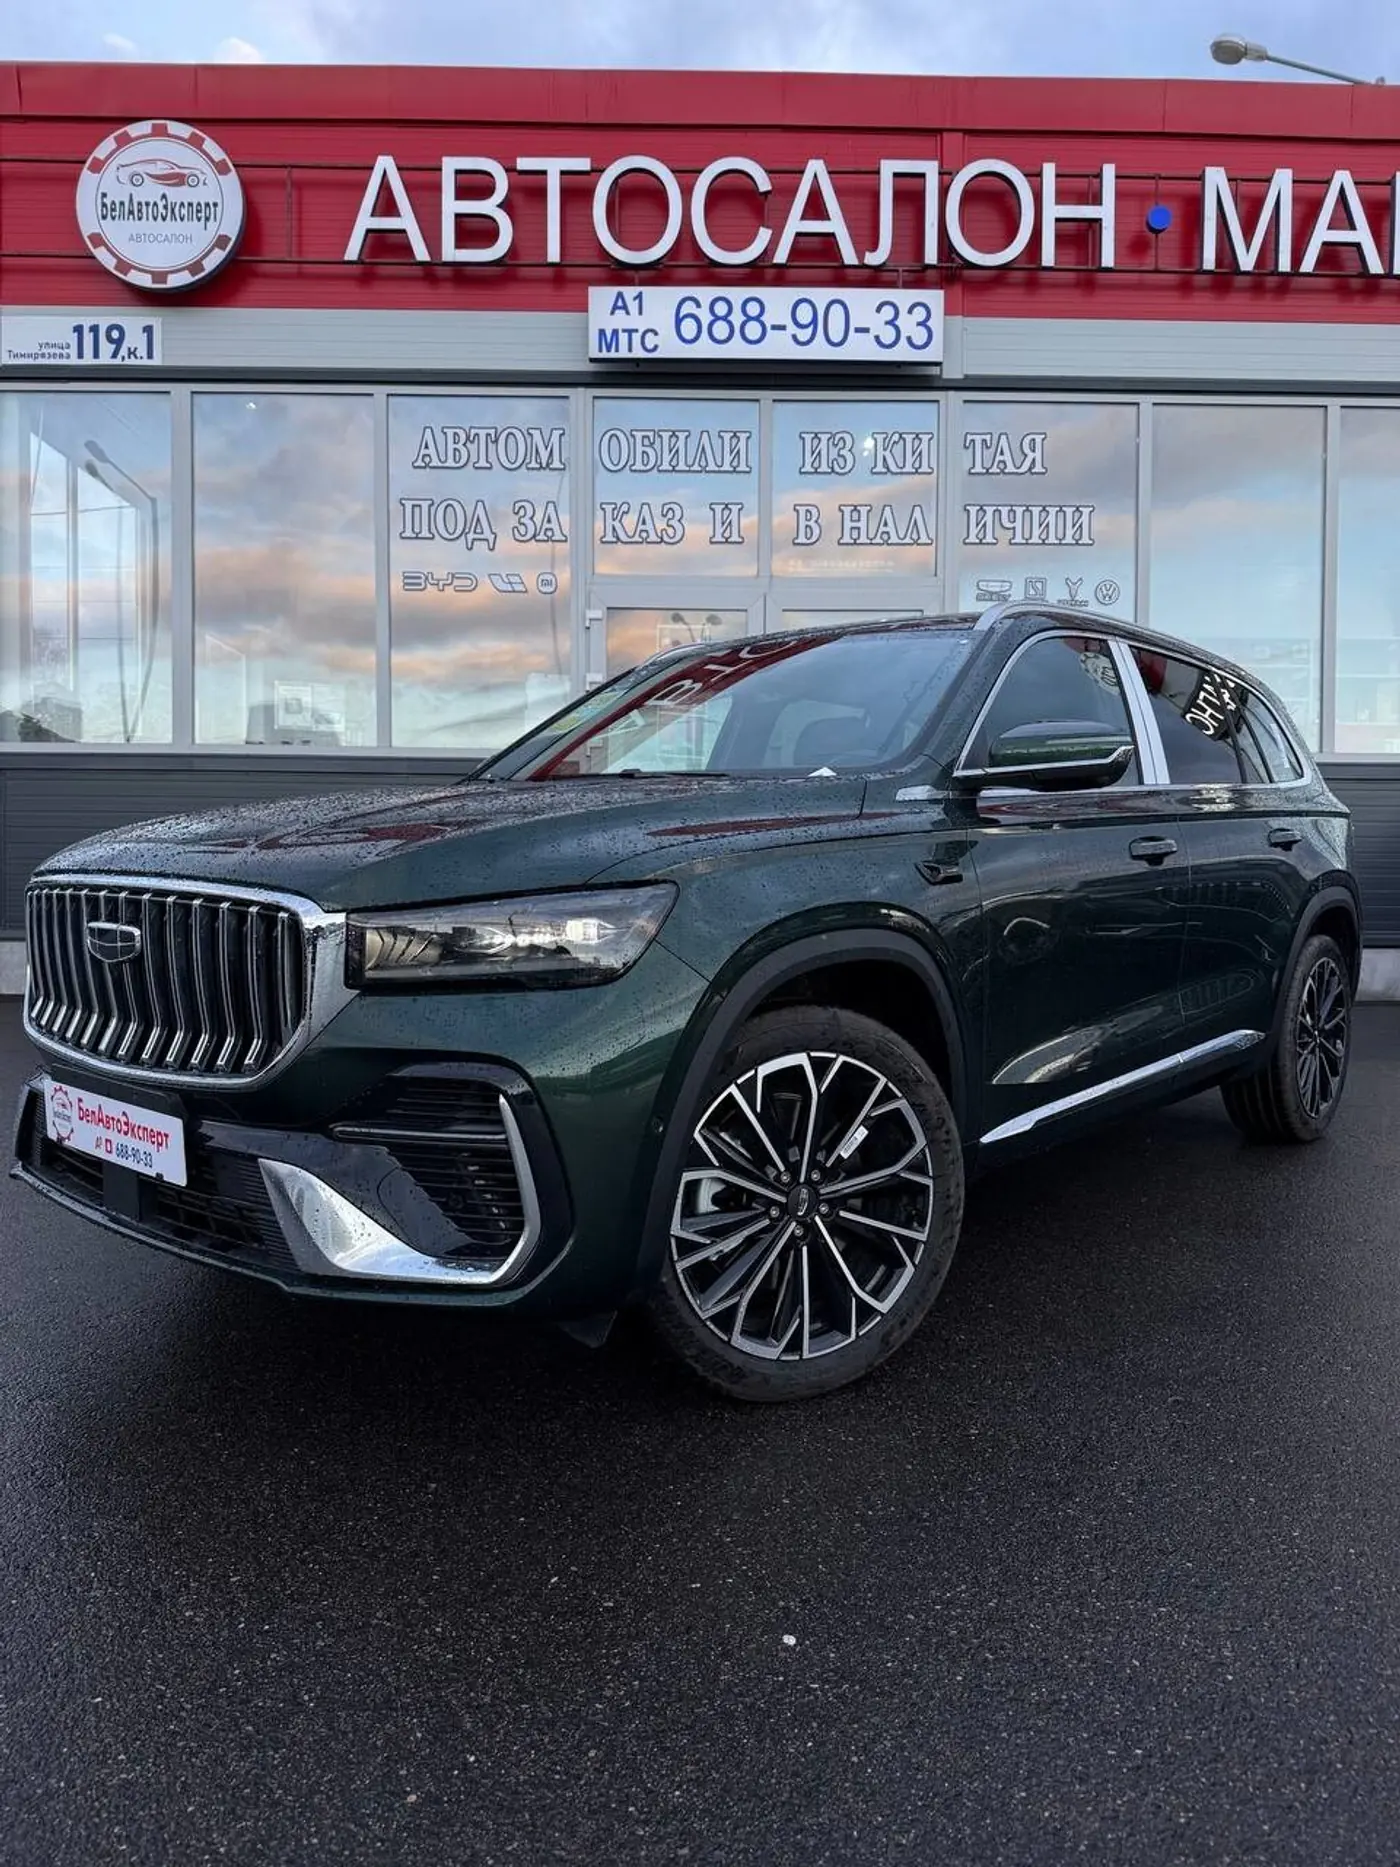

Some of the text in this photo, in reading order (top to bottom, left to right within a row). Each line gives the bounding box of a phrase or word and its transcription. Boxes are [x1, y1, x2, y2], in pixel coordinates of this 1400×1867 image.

[100, 192, 219, 231] БелАвтоЭксперт
[343, 155, 1400, 275] АВТОСАЛОН МА
[128, 233, 193, 245] АВТОСАЛОН
[597, 328, 660, 353] МТС
[674, 296, 935, 350] 688-90-33
[7, 350, 71, 361] Тимирязева
[38, 342, 71, 351] улица
[799, 431, 855, 475] ИЗ
[400, 498, 497, 551] ПОД
[709, 502, 745, 545] И
[793, 504, 821, 545] В
[76, 1097, 171, 1152] БелАвтоЭксперт
[116, 1142, 153, 1168] 688-90-33
